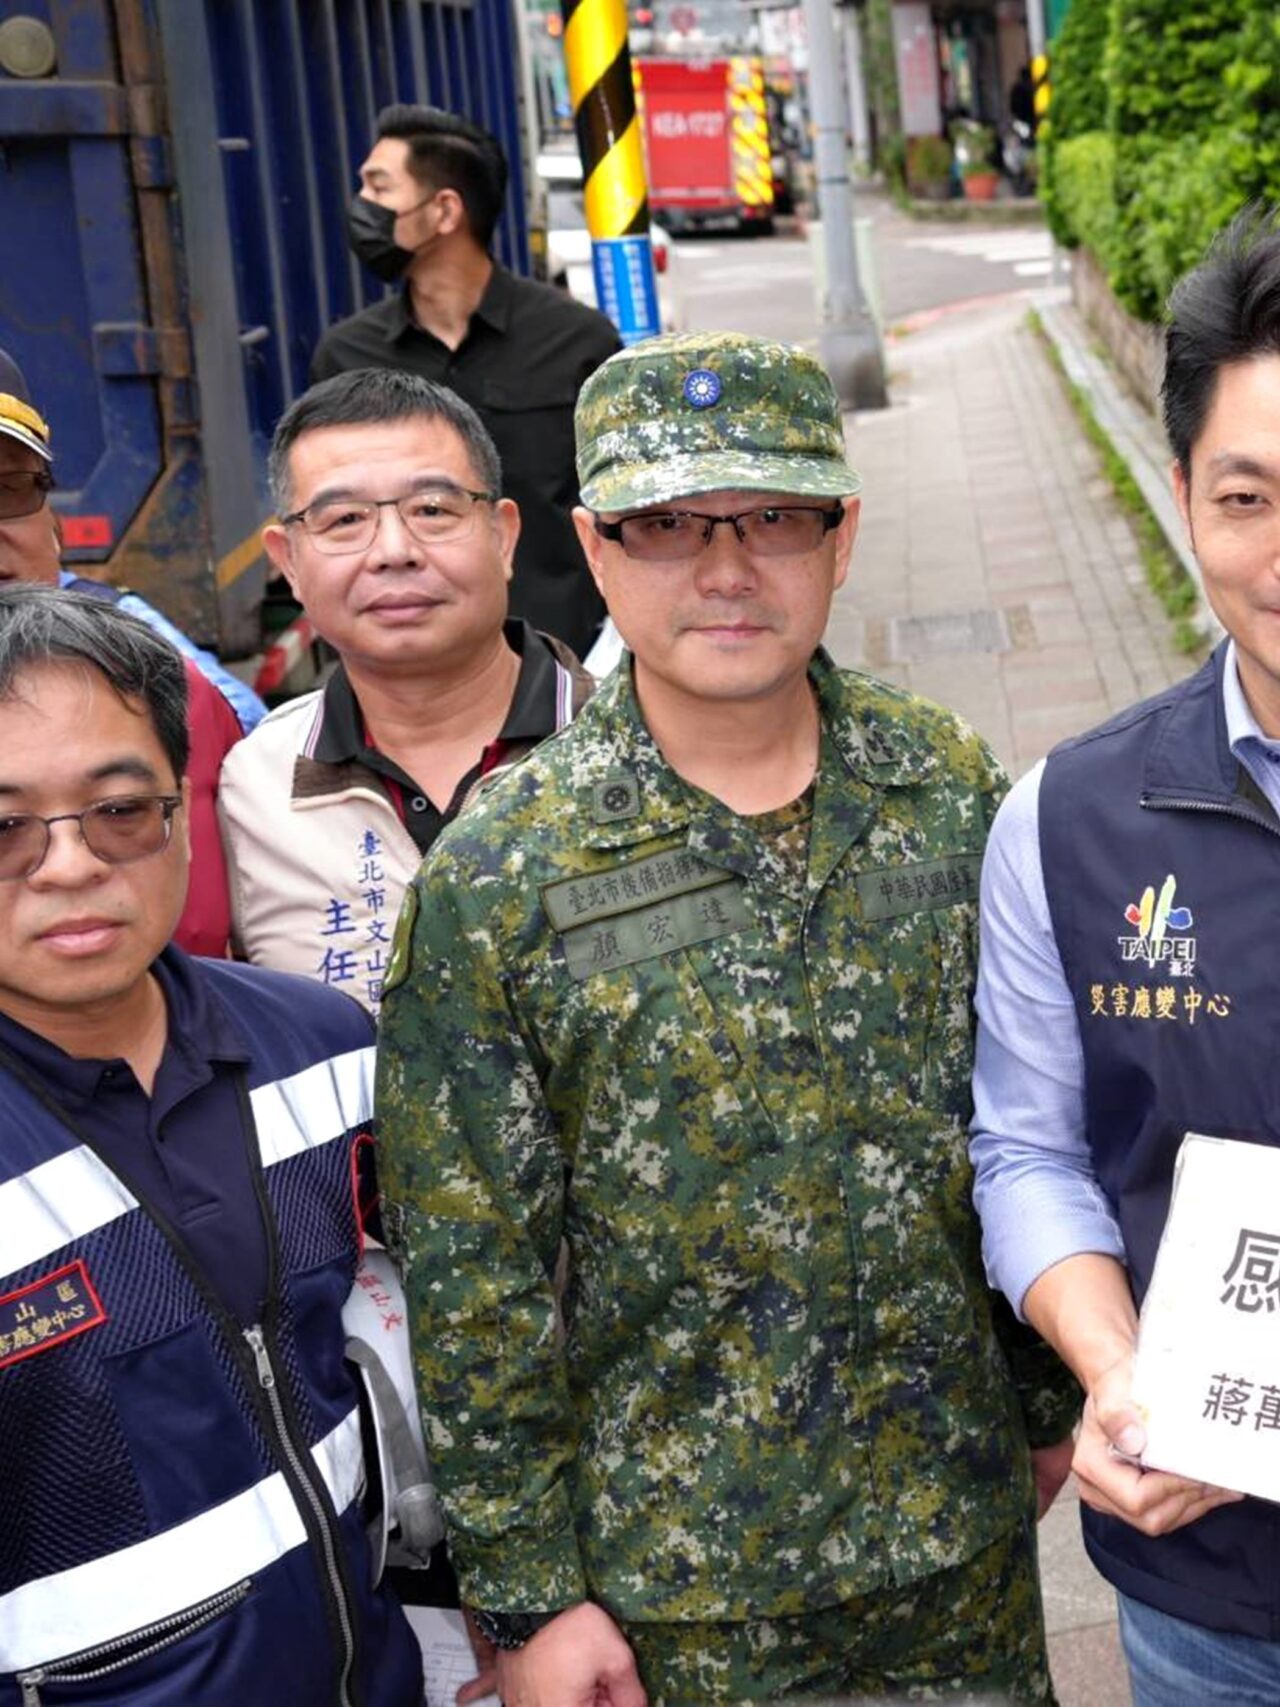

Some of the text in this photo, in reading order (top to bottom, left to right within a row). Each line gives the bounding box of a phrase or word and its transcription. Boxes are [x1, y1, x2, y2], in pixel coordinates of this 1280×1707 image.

[316, 898, 357, 984] 主任
[1117, 936, 1197, 963] TAIPEI
[1090, 983, 1232, 1026] 災害應變中心
